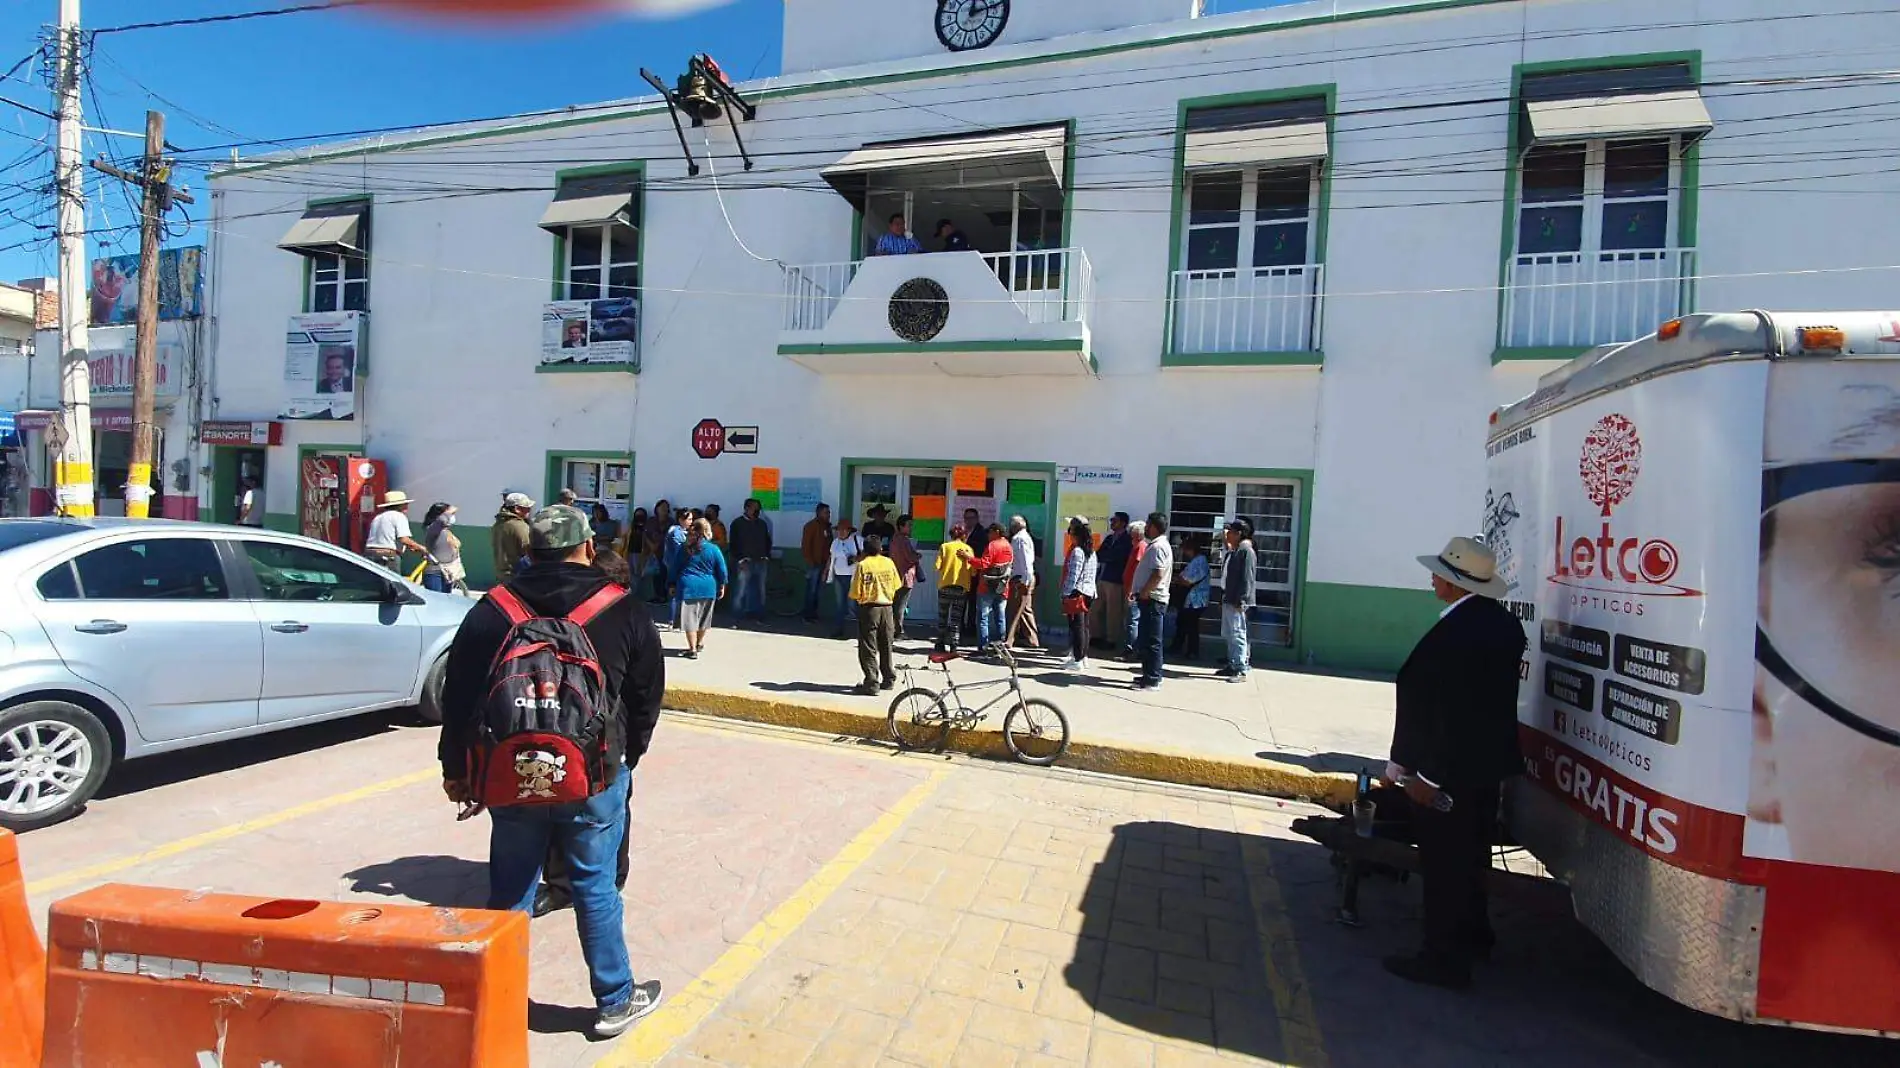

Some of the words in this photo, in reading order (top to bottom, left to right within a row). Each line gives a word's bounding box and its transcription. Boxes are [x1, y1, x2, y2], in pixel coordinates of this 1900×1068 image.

[698, 428, 720, 437] ALTO
[1554, 515, 1679, 585] Letco
[1570, 594, 1645, 616] OPTICOS
[1629, 644, 1654, 663] VENTA
[1655, 650, 1670, 666] DE
[1623, 660, 1680, 687] ACCESORIOS
[1654, 704, 1669, 721] DE
[1553, 754, 1678, 854] GRATIS
